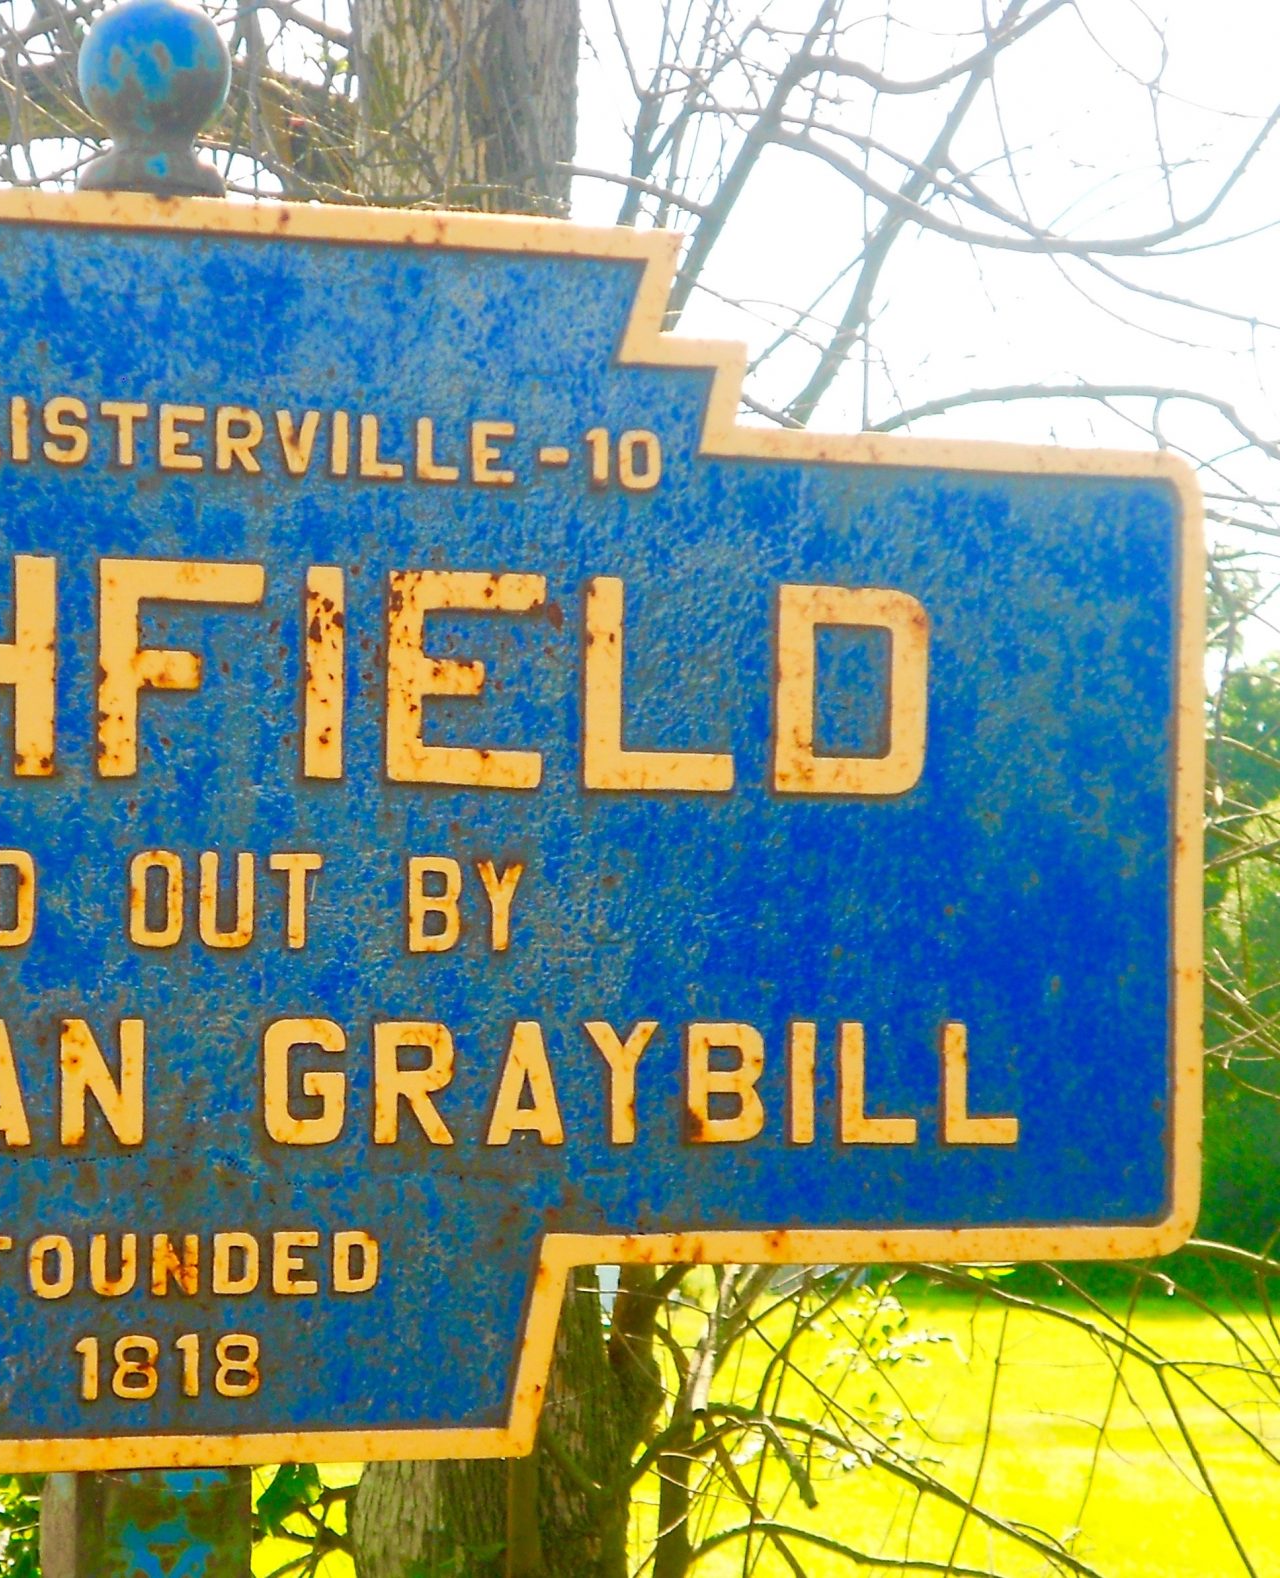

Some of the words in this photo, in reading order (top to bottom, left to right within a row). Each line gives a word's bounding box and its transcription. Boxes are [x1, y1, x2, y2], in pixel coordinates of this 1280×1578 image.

[129, 849, 323, 950] OUT
[407, 855, 523, 953] BY
[263, 1017, 1019, 1146] GRAYBILL
[74, 1332, 260, 1401] 1818
